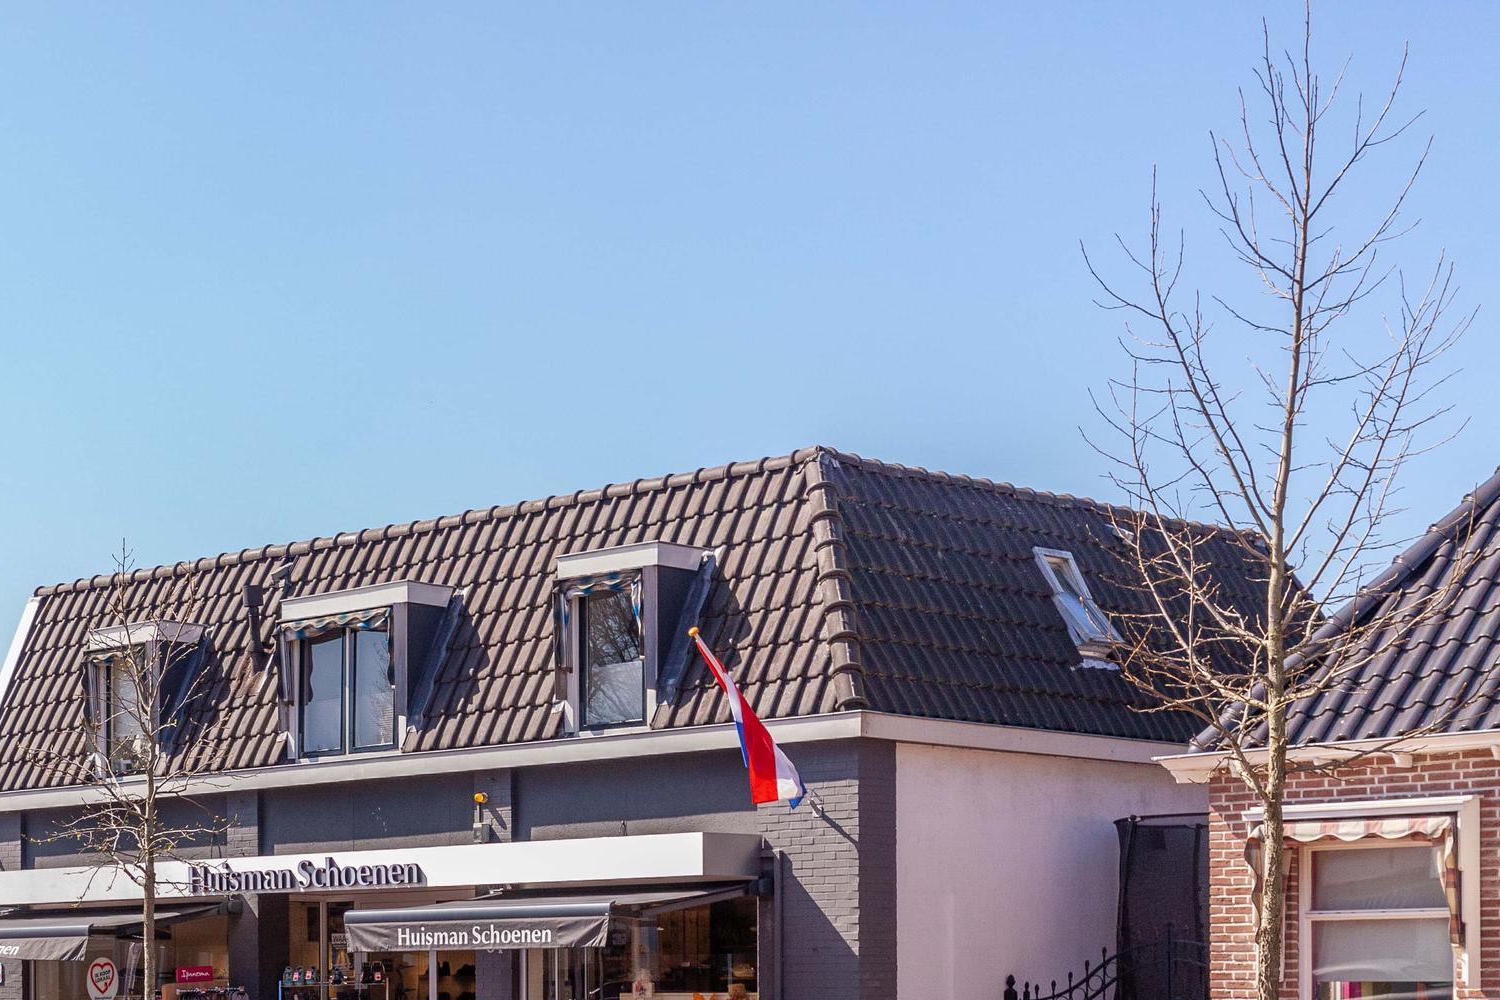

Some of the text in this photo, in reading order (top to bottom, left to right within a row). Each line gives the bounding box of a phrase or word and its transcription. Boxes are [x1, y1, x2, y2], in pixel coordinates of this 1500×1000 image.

[187, 856, 424, 894] Huisman Schoenen
[397, 924, 552, 946] Huisman Schoenen
